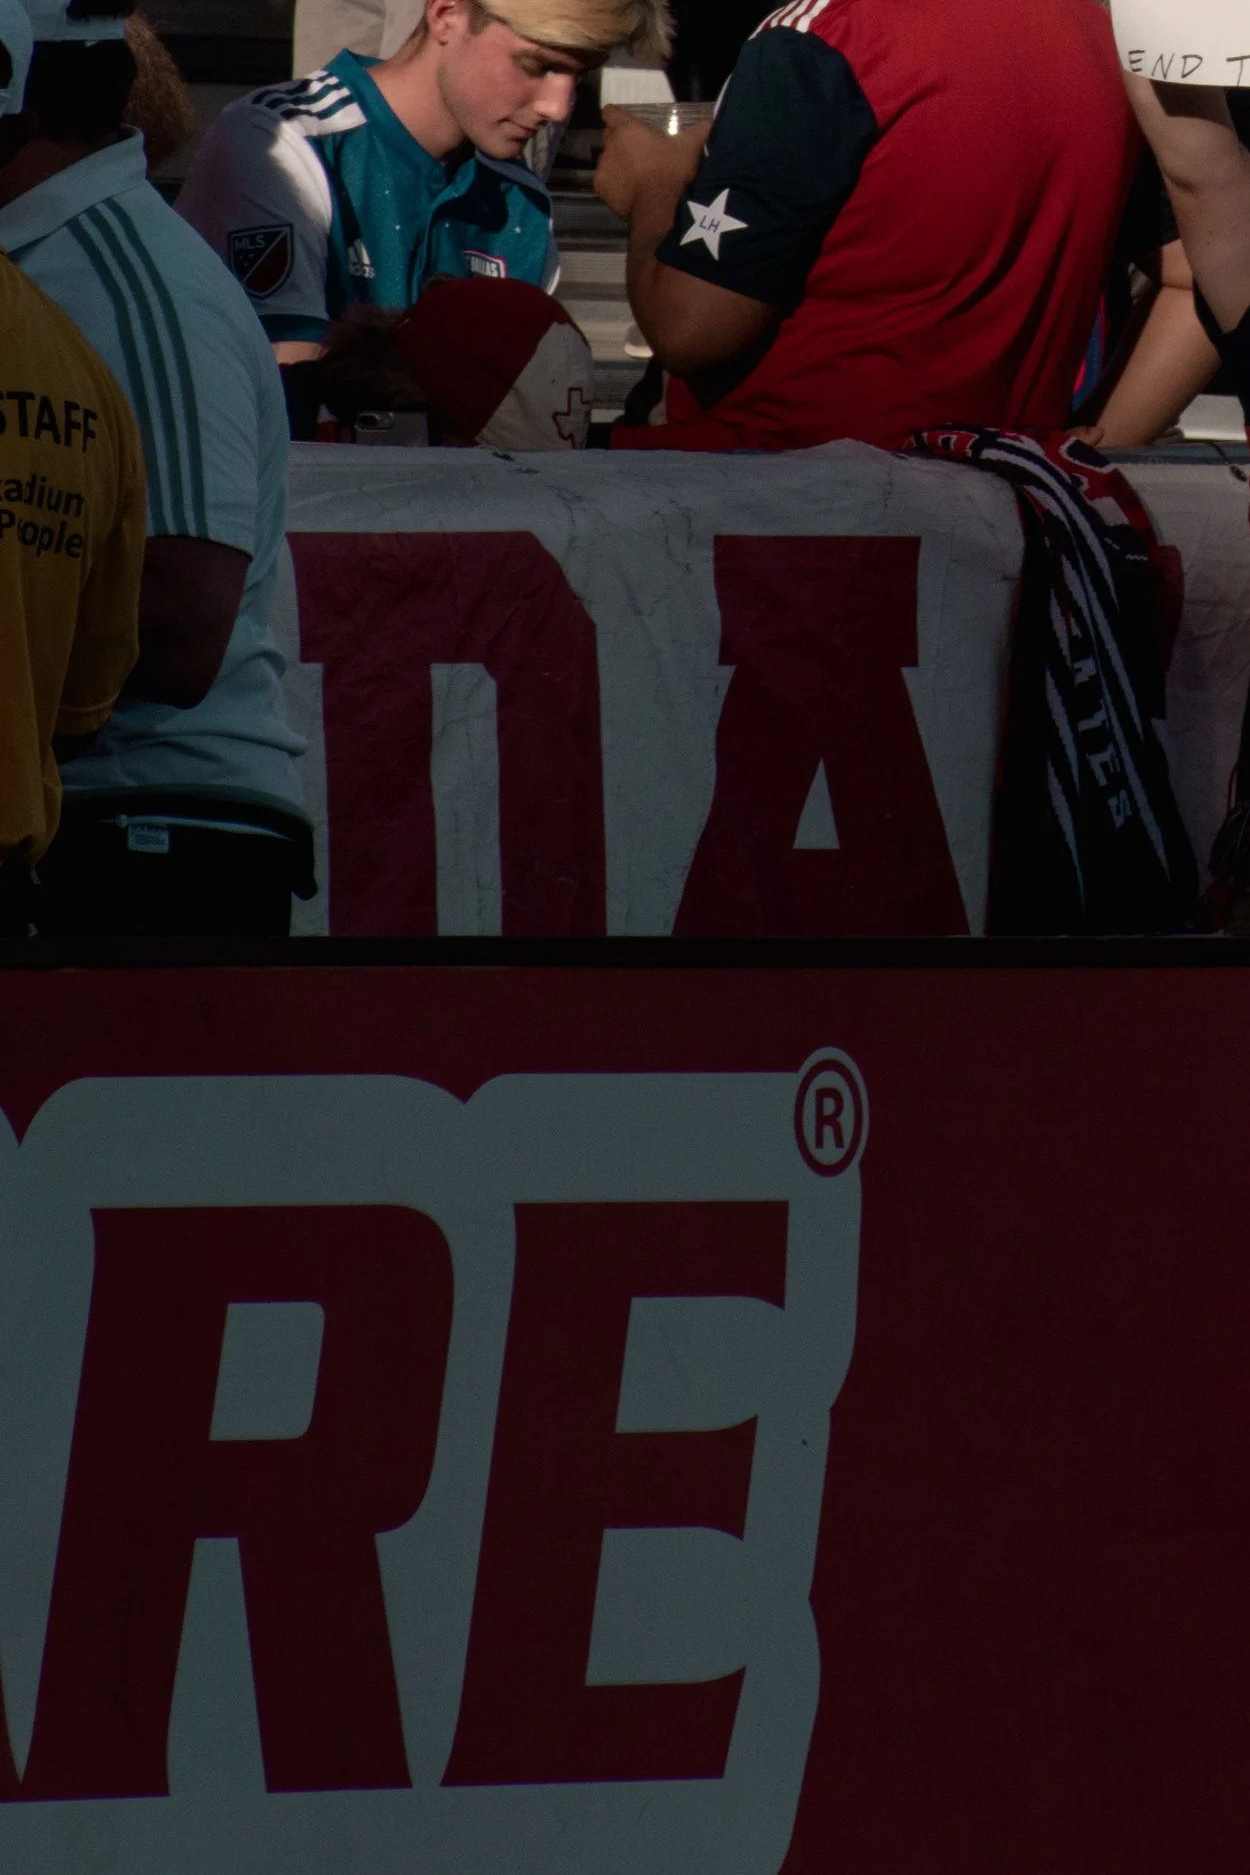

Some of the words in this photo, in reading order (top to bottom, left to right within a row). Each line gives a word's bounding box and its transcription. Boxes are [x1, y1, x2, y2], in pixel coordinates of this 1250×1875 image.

[1128, 49, 1204, 81] END
[234, 233, 265, 251] MLS
[698, 214, 722, 234] LH
[0, 473, 85, 518] adium
[0, 508, 83, 558] Pople
[0, 1199, 791, 1803] RE
